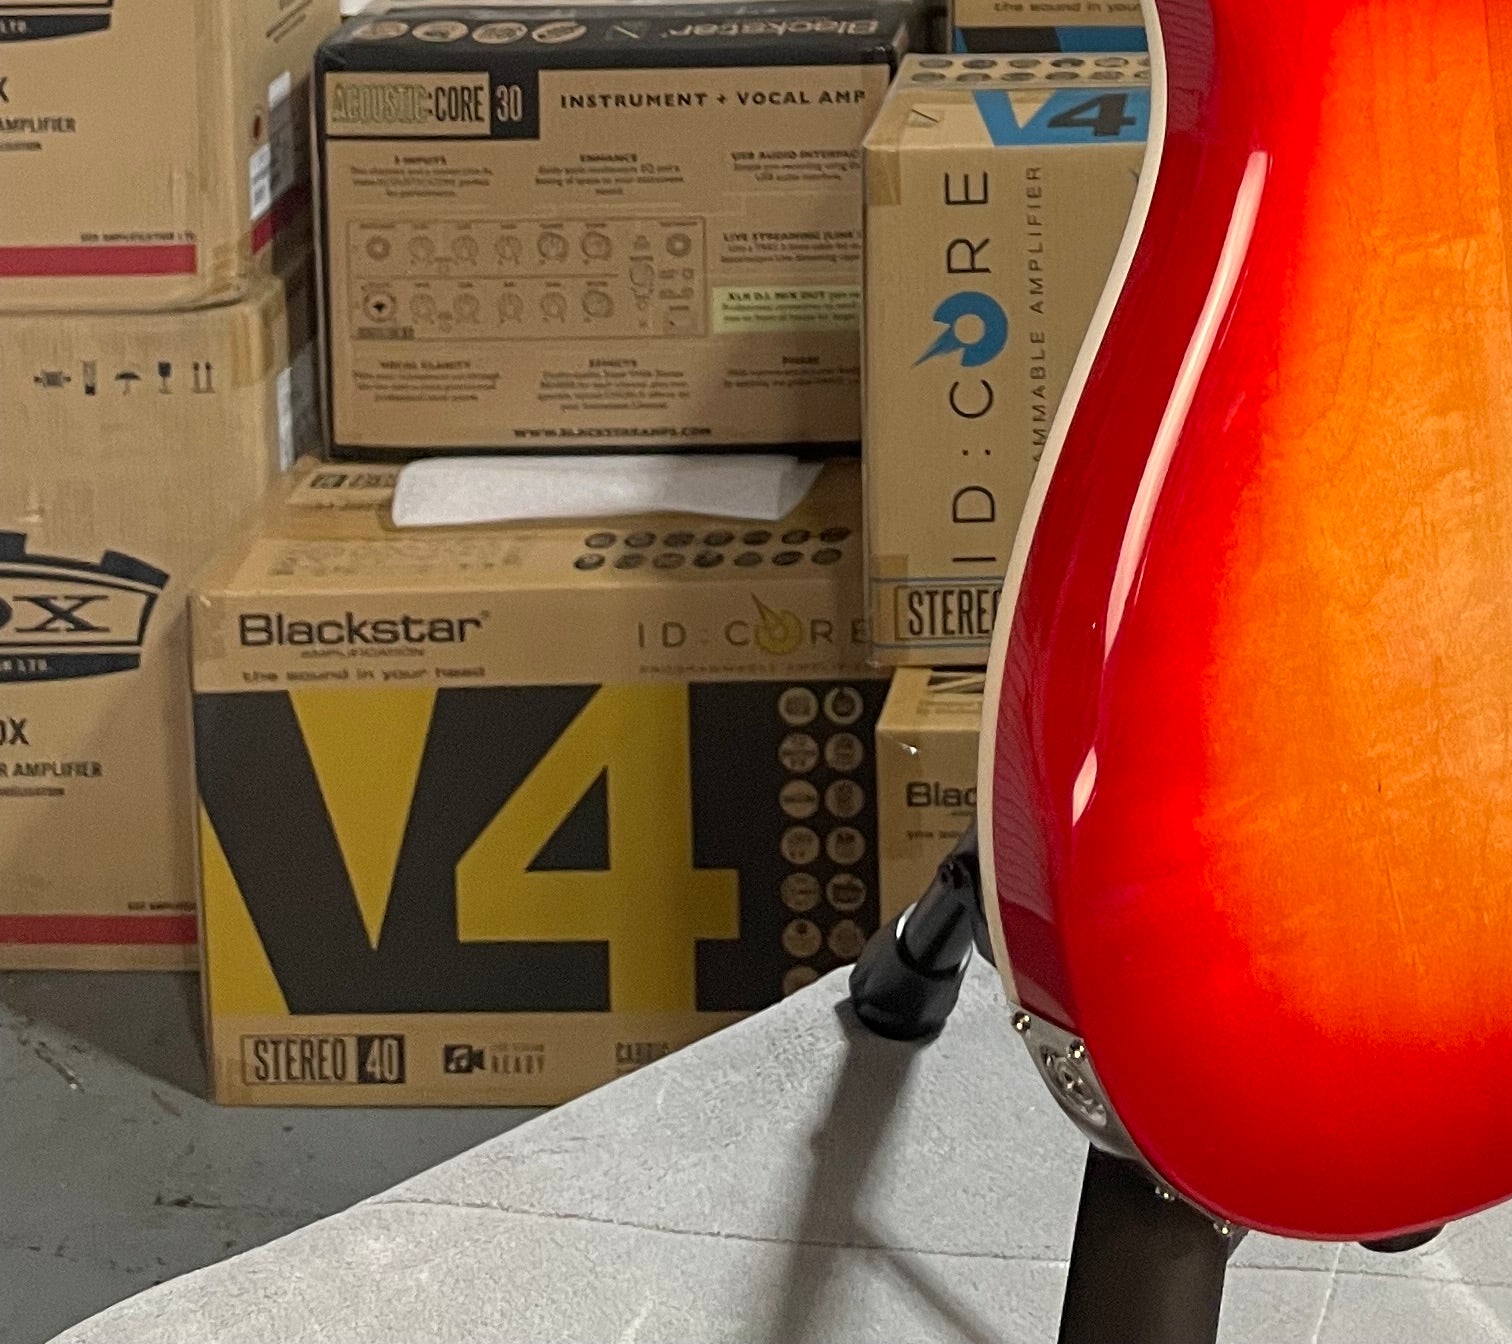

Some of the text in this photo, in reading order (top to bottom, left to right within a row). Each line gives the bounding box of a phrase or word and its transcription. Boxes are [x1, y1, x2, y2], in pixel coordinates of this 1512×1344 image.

[496, 84, 523, 123] 30
[560, 92, 708, 109] INSTRUMENT
[737, 89, 811, 106] VOCAL
[818, 89, 866, 105] AMP
[1024, 166, 1045, 315] AMPLIFIER
[238, 611, 483, 647] Blackstar
[242, 671, 279, 682] the
[286, 670, 349, 681] sound
[356, 669, 375, 680] in
[382, 668, 427, 681] your
[193, 682, 741, 1015] V4
[253, 1038, 401, 1083] STEREO 40
